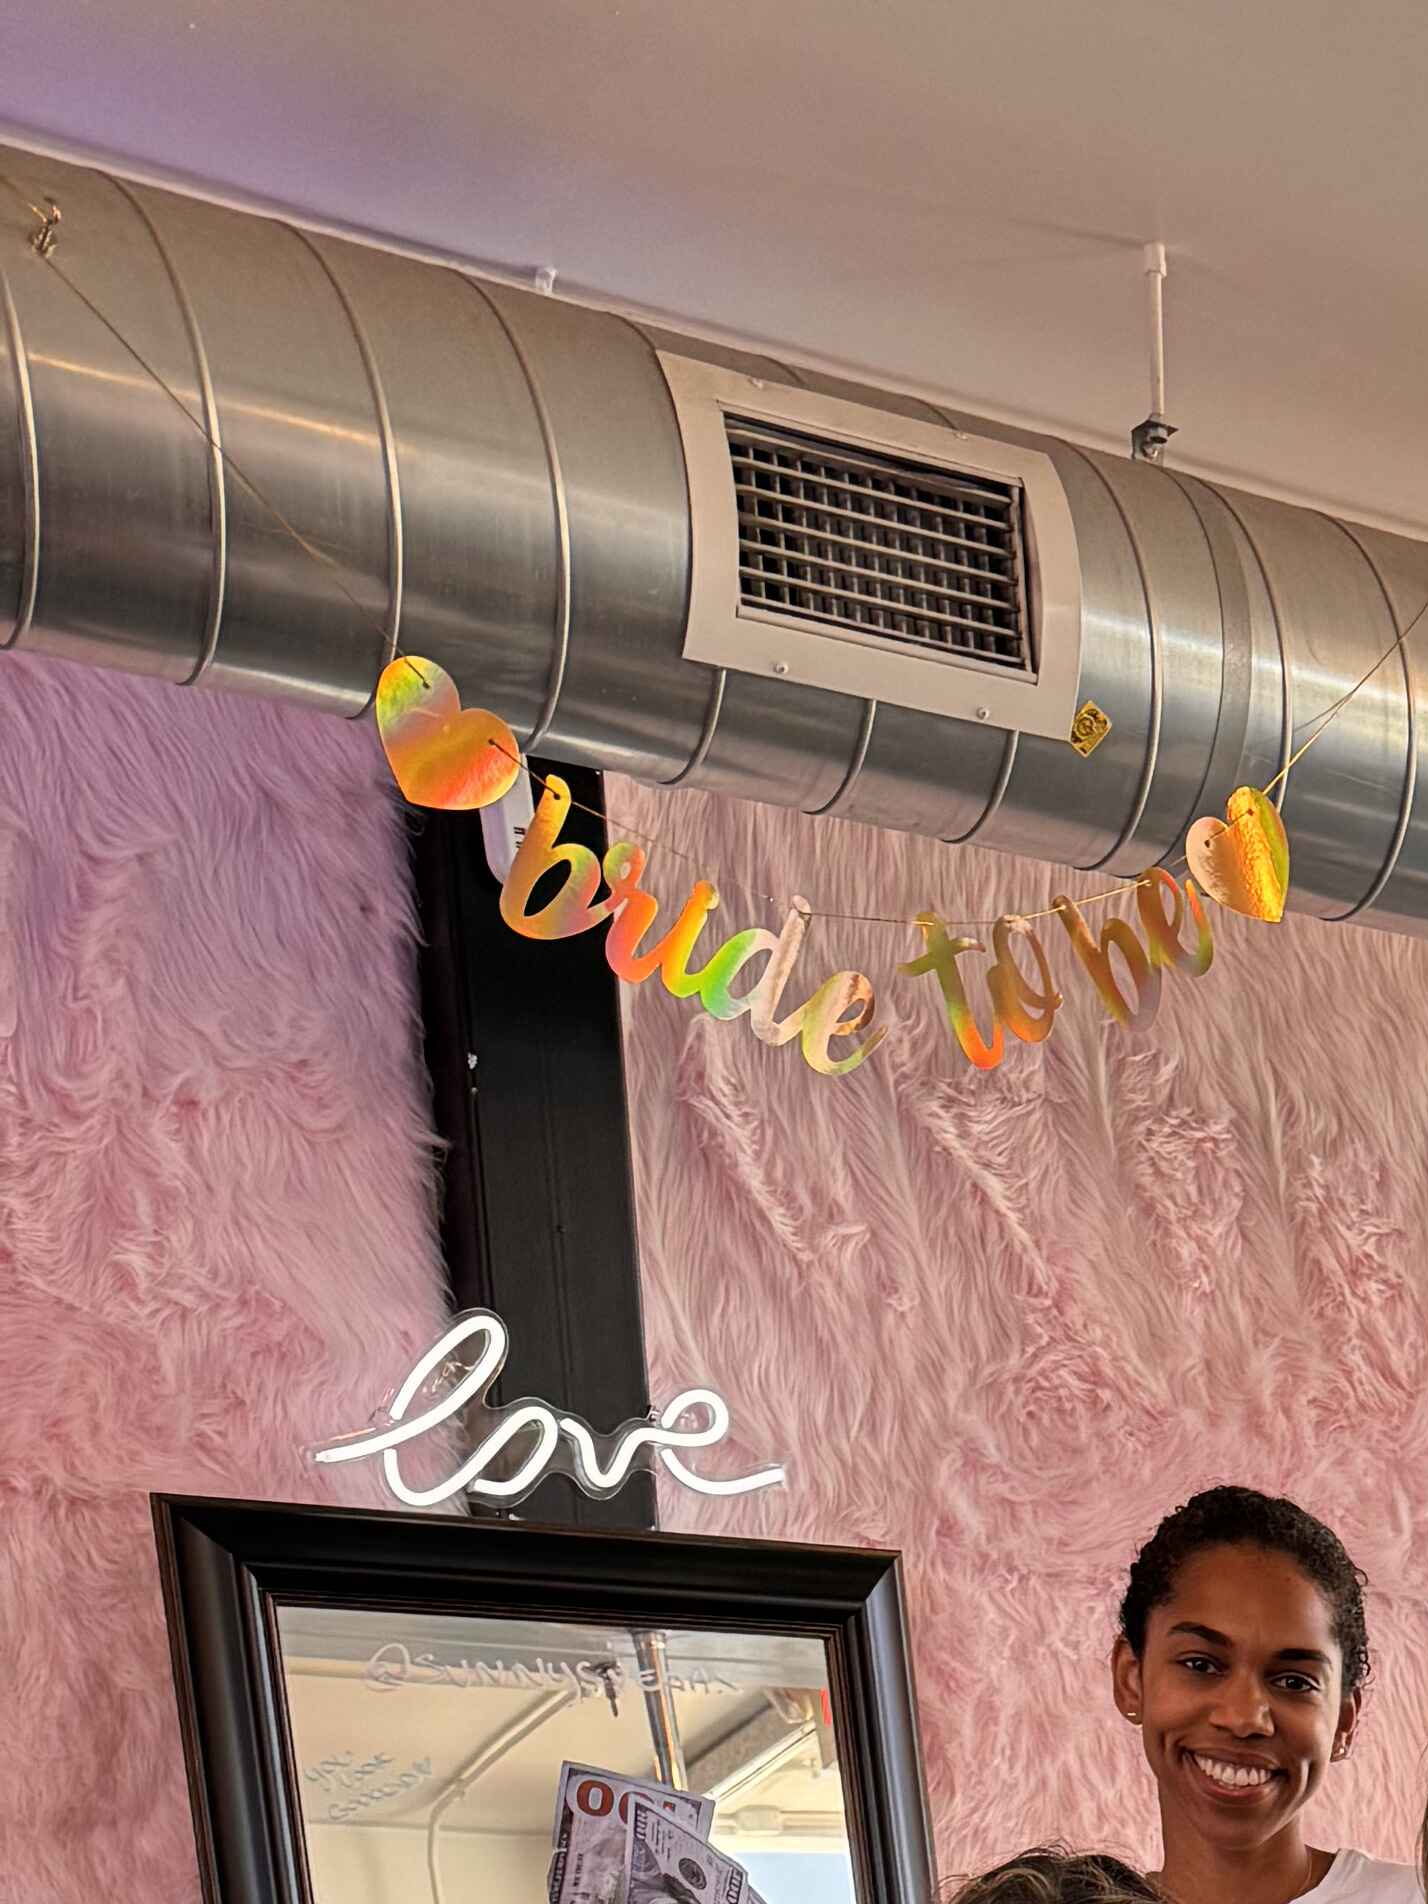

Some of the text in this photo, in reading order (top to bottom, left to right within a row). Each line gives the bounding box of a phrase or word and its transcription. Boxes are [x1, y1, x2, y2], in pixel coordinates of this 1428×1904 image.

[499, 774, 1213, 1075] bride to be
[316, 1314, 786, 1505] love
